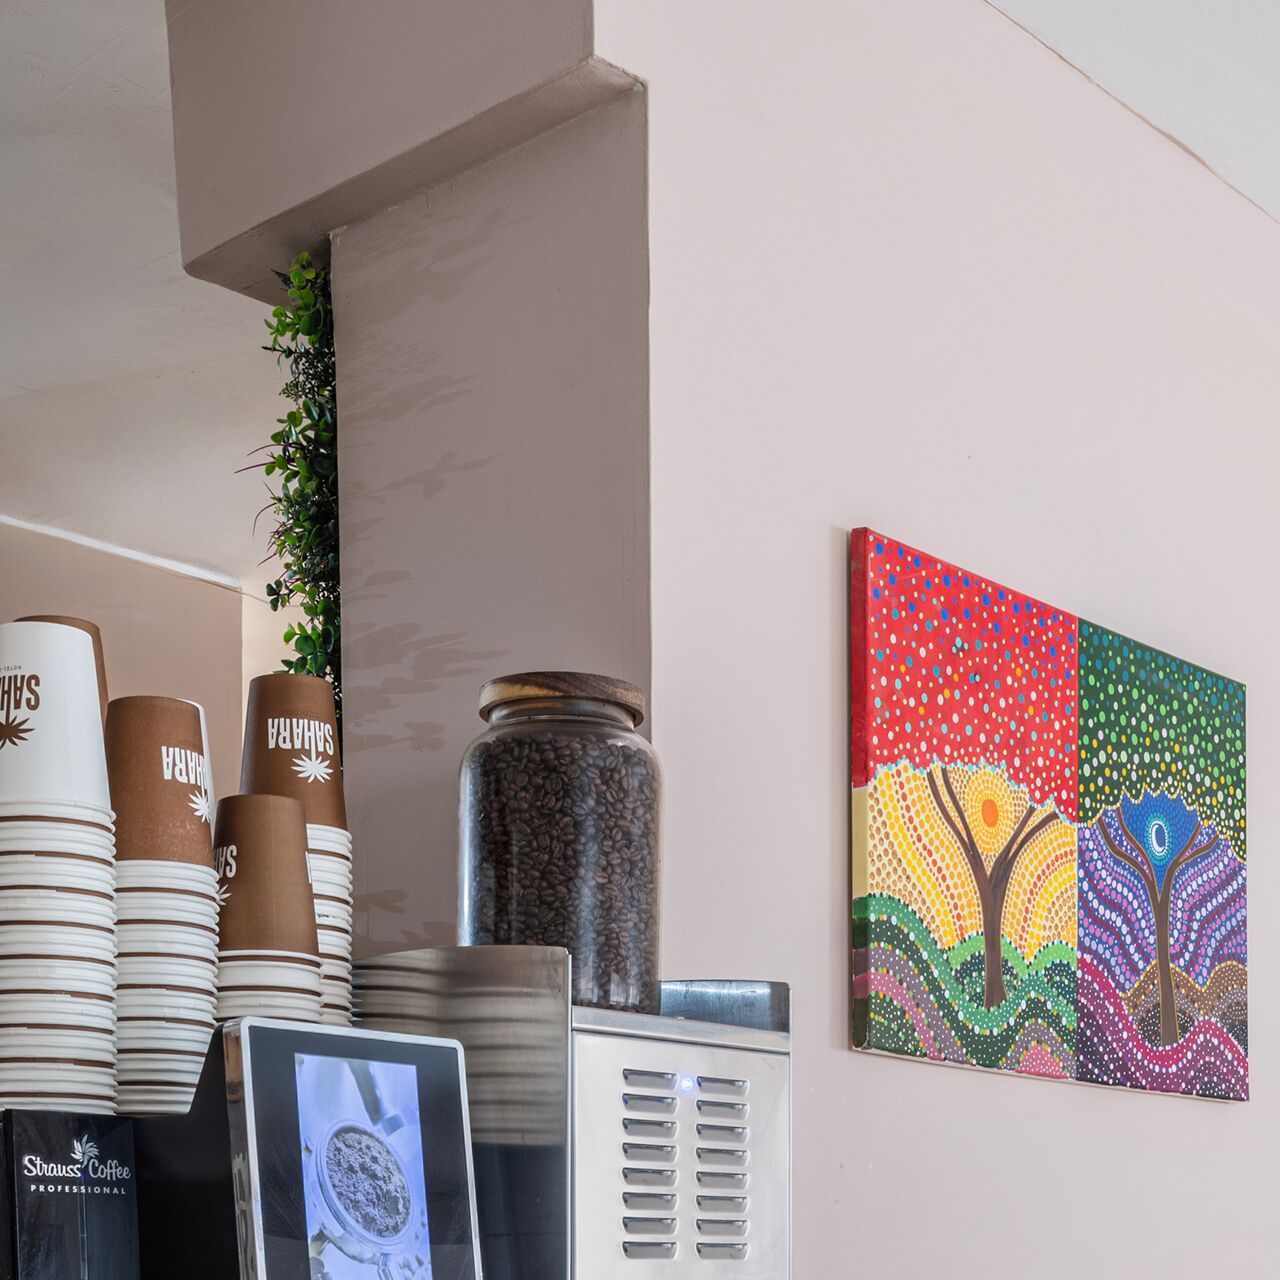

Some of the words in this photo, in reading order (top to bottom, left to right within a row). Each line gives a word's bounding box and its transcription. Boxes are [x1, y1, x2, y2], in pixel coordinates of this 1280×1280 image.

[267, 717, 334, 756] SAHARA
[23, 1155, 82, 1178] Strauss
[88, 1159, 132, 1181] Coffee
[30, 1184, 127, 1195] PROFESSIONAL
